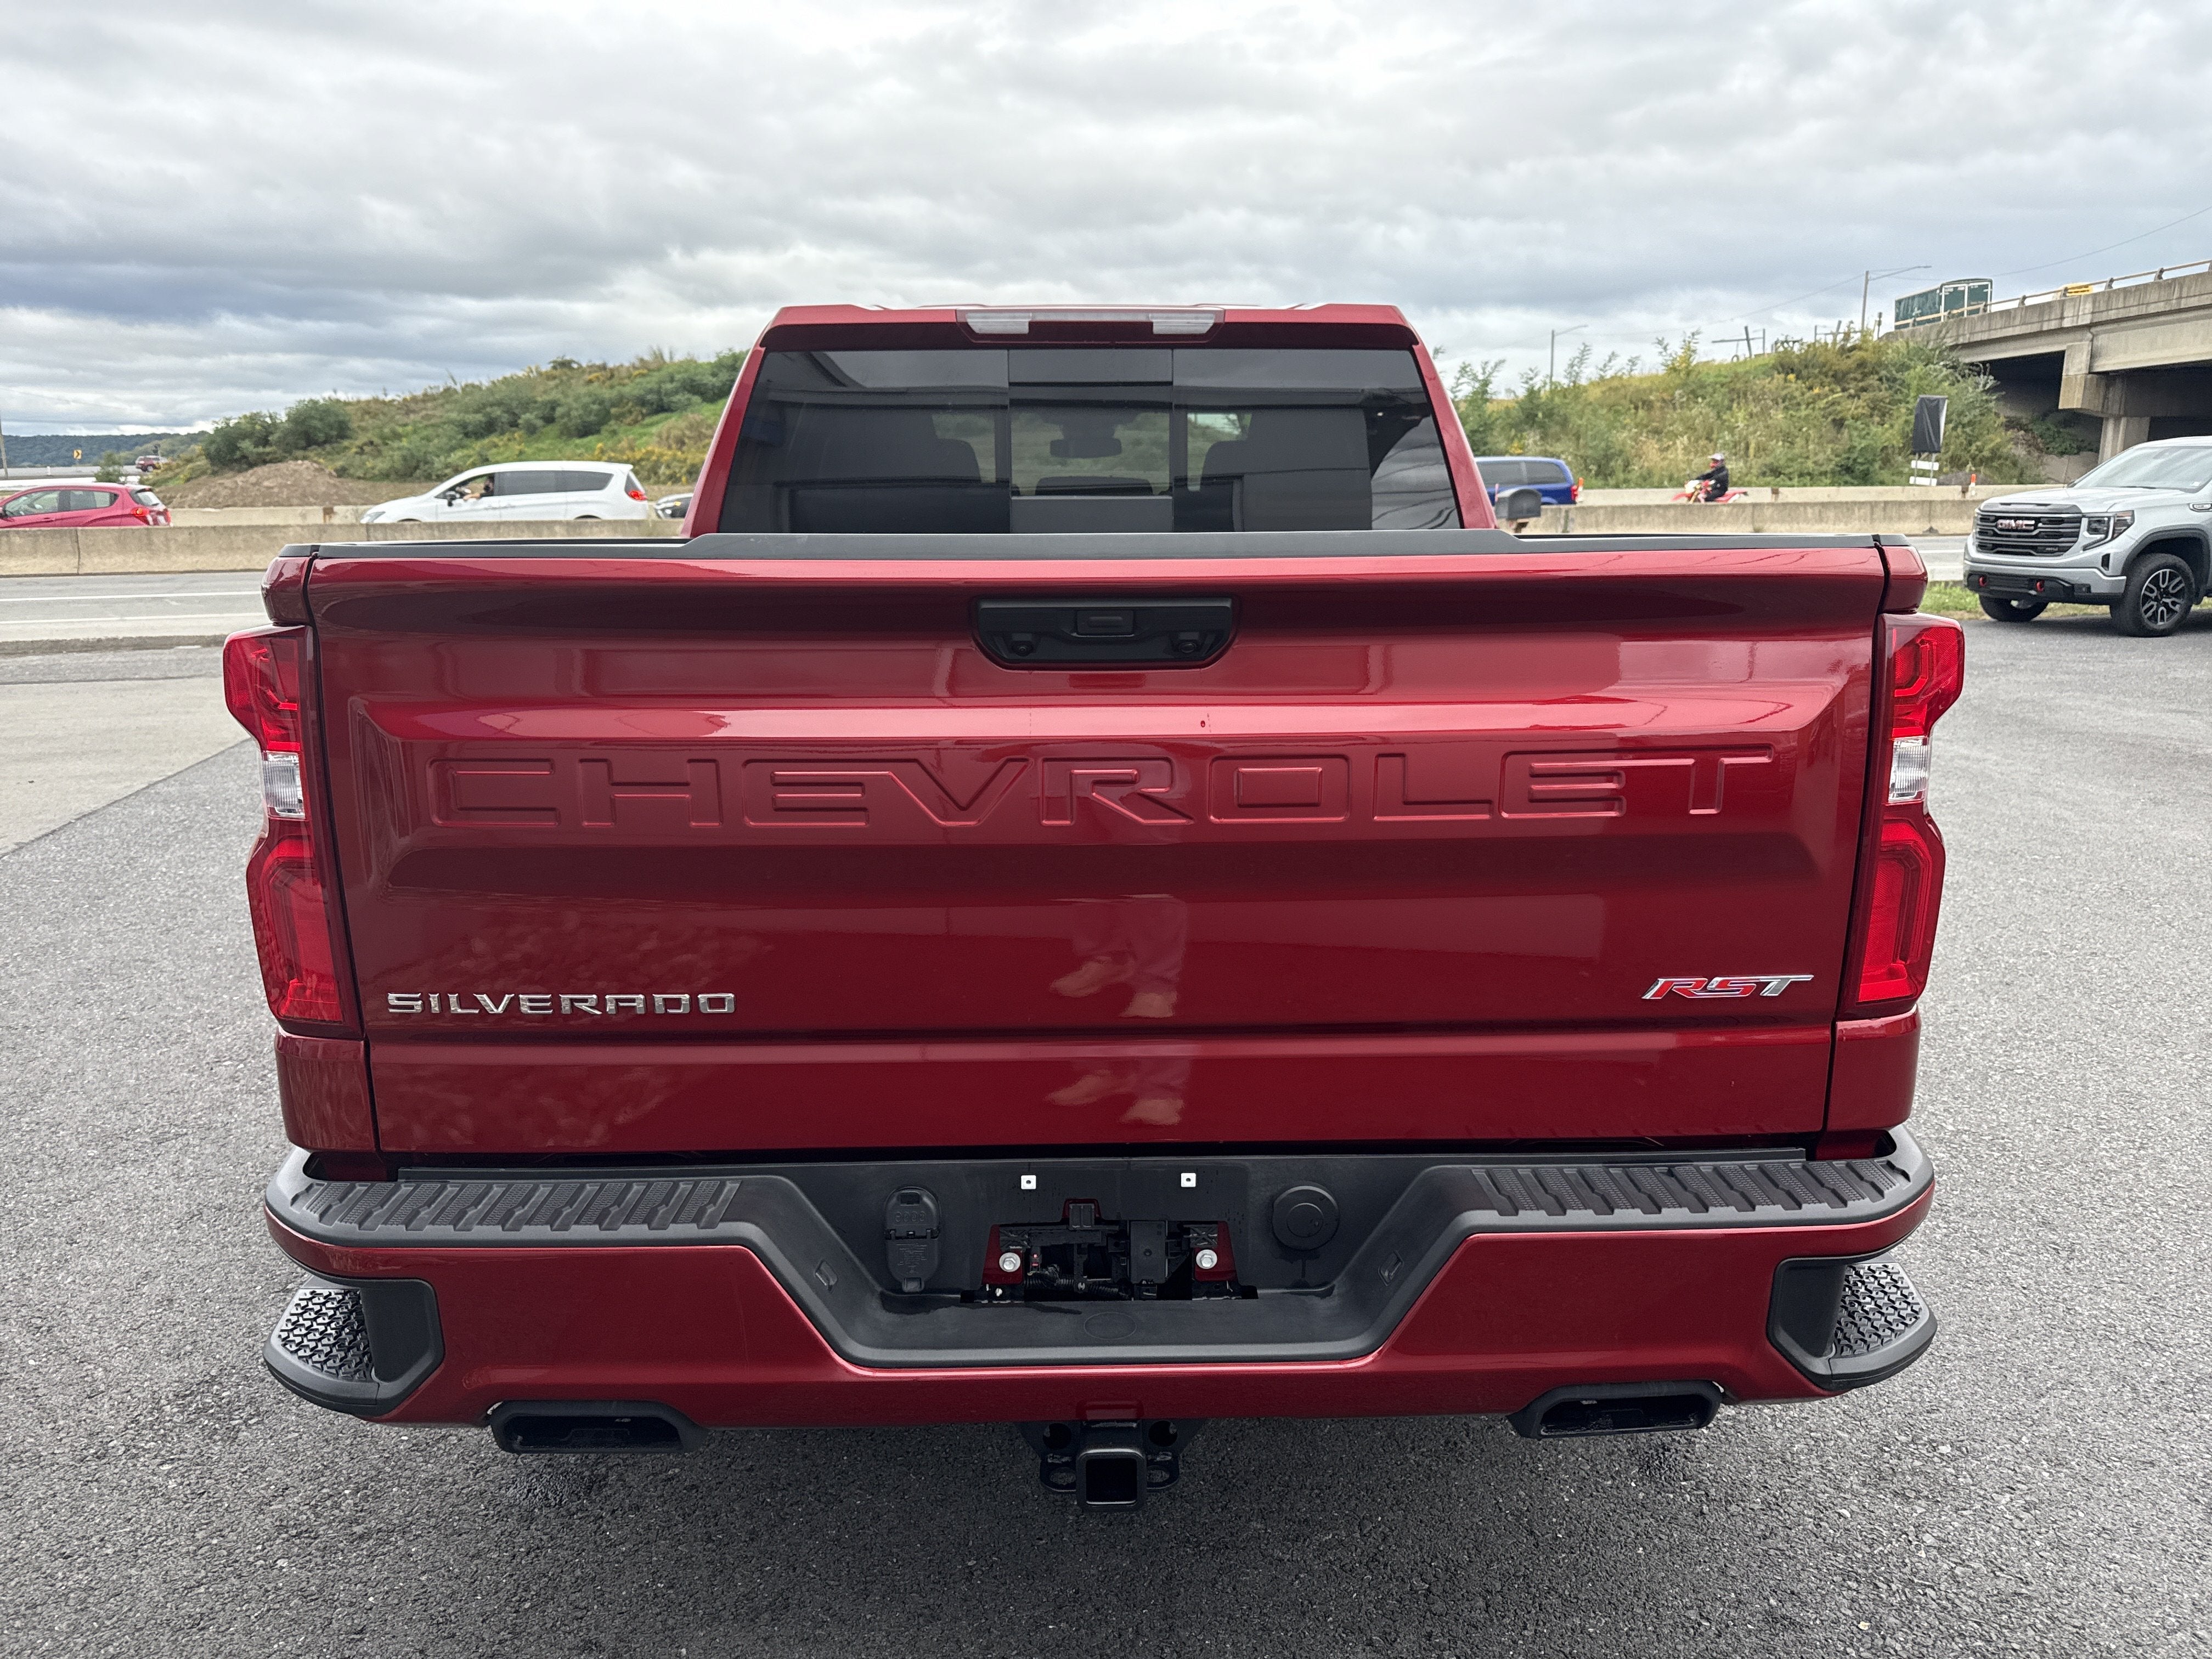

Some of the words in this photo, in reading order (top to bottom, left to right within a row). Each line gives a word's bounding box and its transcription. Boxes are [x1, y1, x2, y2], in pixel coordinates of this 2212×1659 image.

[1997, 519, 2035, 530] GMC
[428, 744, 1774, 827] CHEVROLET
[1641, 974, 1814, 1000] RST
[387, 992, 737, 1014] SILVERADO
